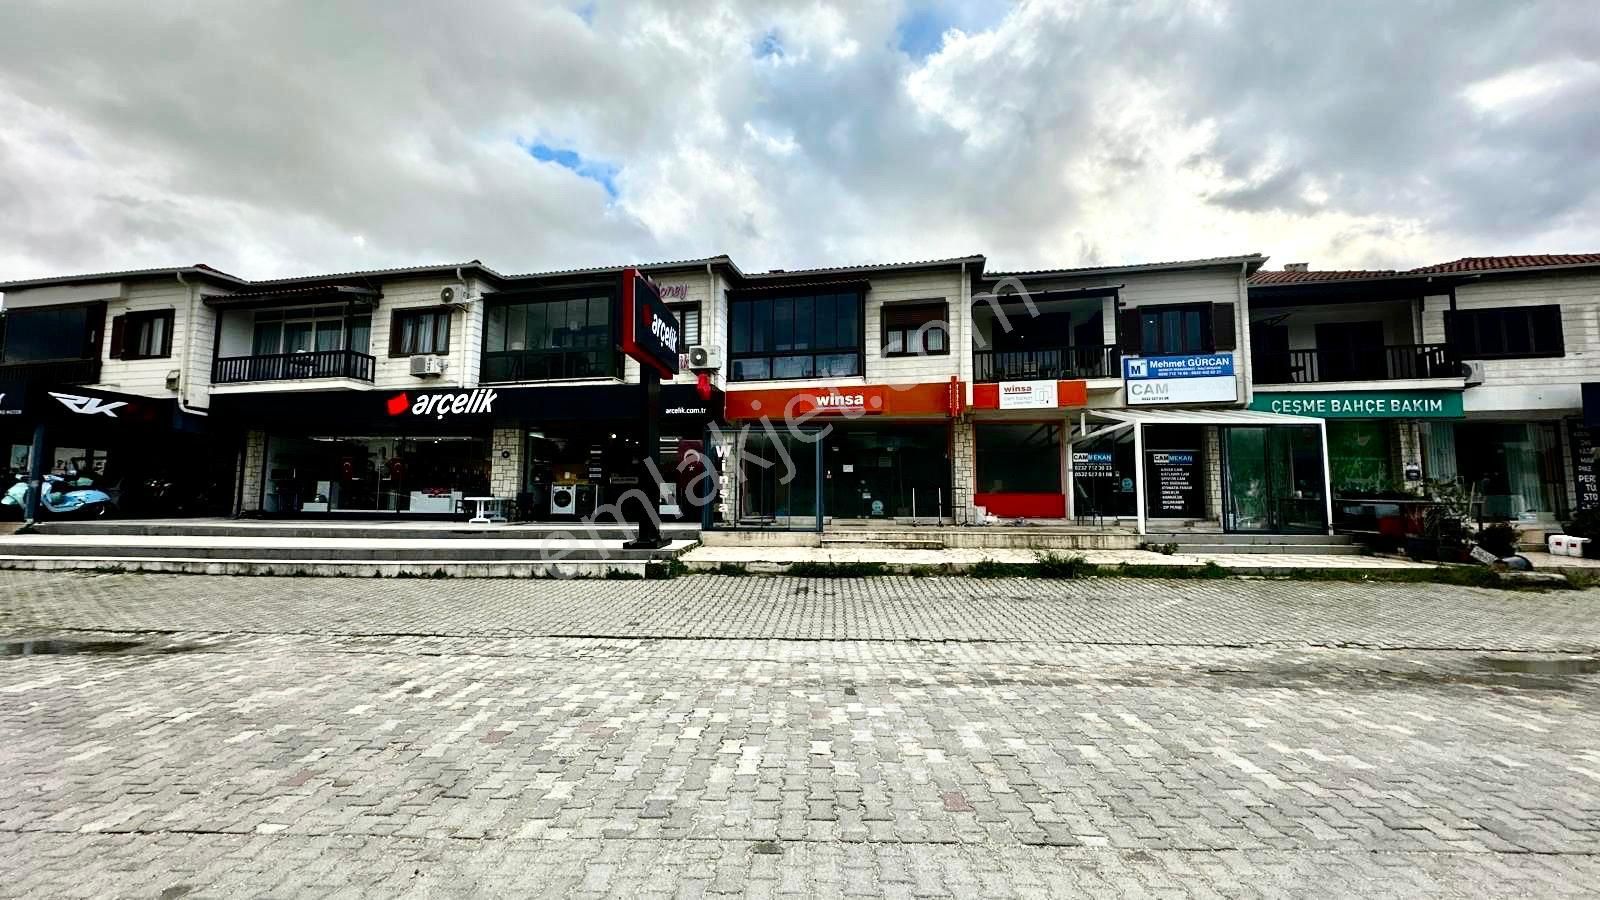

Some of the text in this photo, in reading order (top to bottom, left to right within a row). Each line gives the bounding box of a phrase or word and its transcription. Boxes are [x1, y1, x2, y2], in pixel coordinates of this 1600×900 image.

[659, 281, 688, 300] oney
[652, 313, 678, 354] arçelik
[1150, 357, 1230, 369] Mehmet GÜRCAN
[1003, 384, 1032, 392] winsa
[1131, 383, 1168, 396] CAM
[411, 388, 498, 420] arçelik
[816, 392, 864, 406] winsa
[665, 406, 706, 415] arcelik.com.tr
[1272, 398, 1443, 415] ÇEŞME BAHÇE BAKIM
